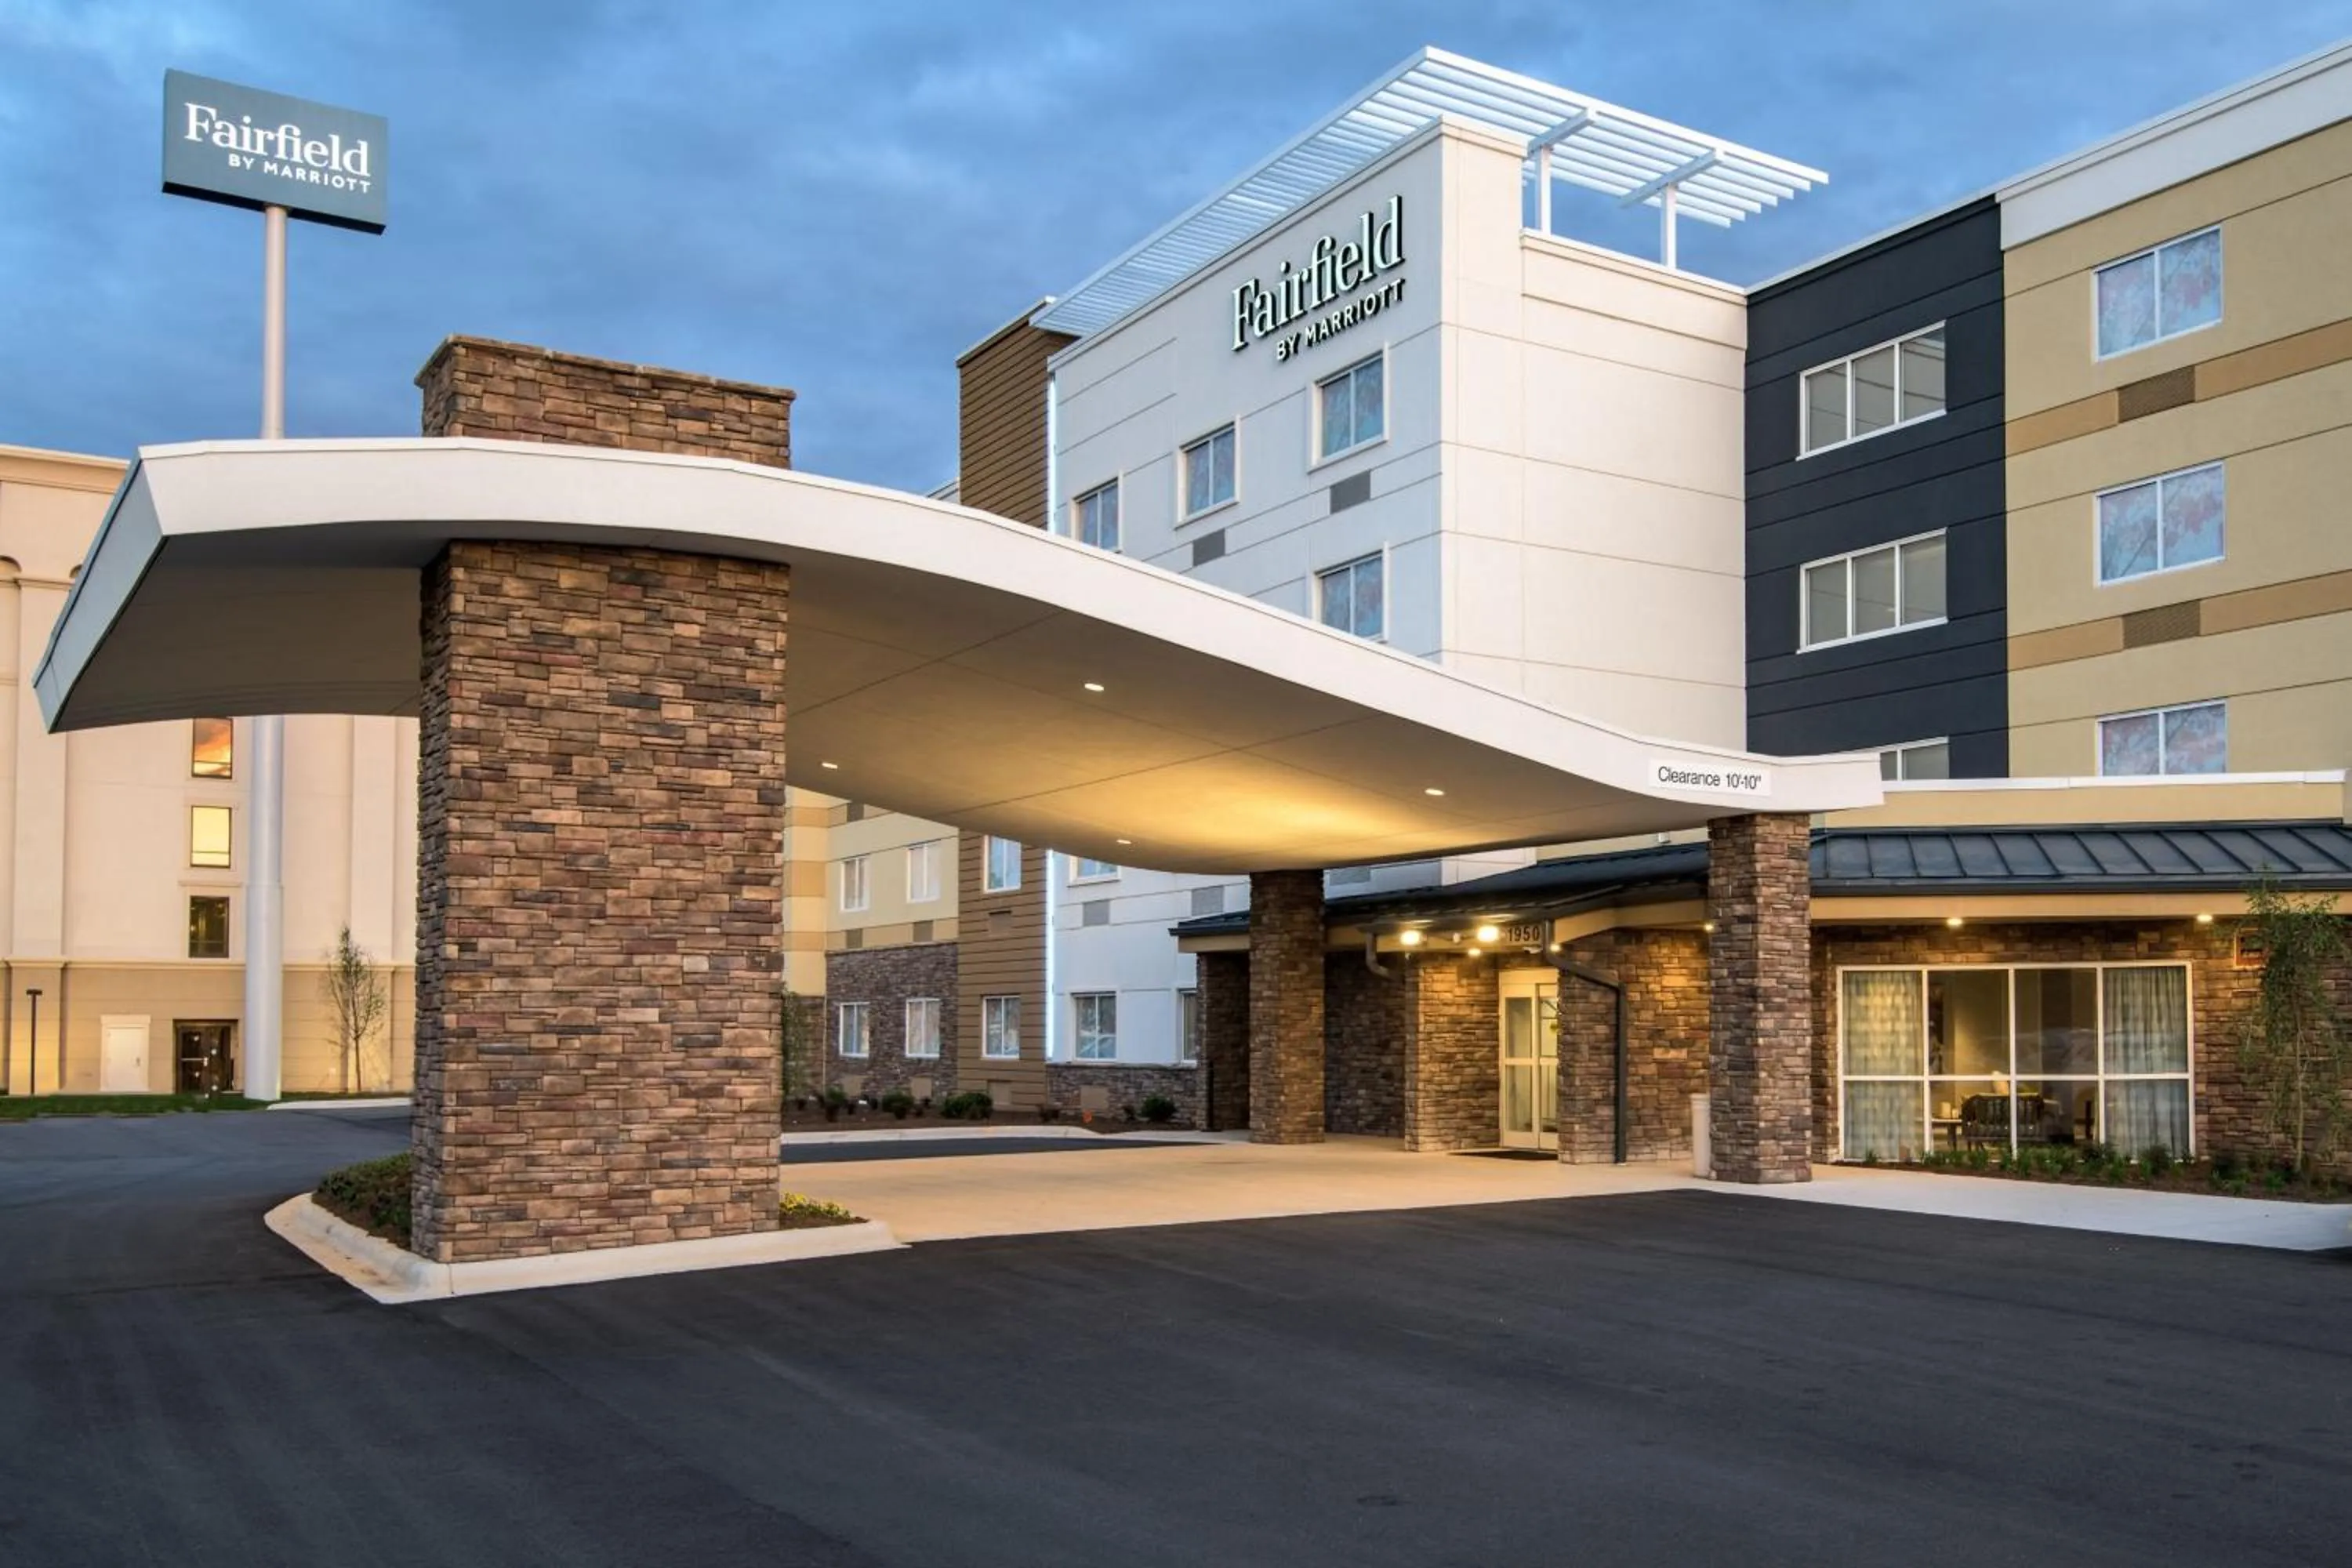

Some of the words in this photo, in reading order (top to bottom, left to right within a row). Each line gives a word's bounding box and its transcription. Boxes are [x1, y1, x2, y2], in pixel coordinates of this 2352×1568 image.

[183, 102, 371, 177] Fairfield
[228, 154, 255, 170] BY
[263, 161, 371, 193] MARRIOTT
[1231, 194, 1406, 352] Fairfield
[1276, 333, 1301, 361] BY
[1304, 278, 1406, 347] MARRIOTT
[1658, 766, 1721, 787] Clearance
[1508, 925, 1541, 942] 1950
